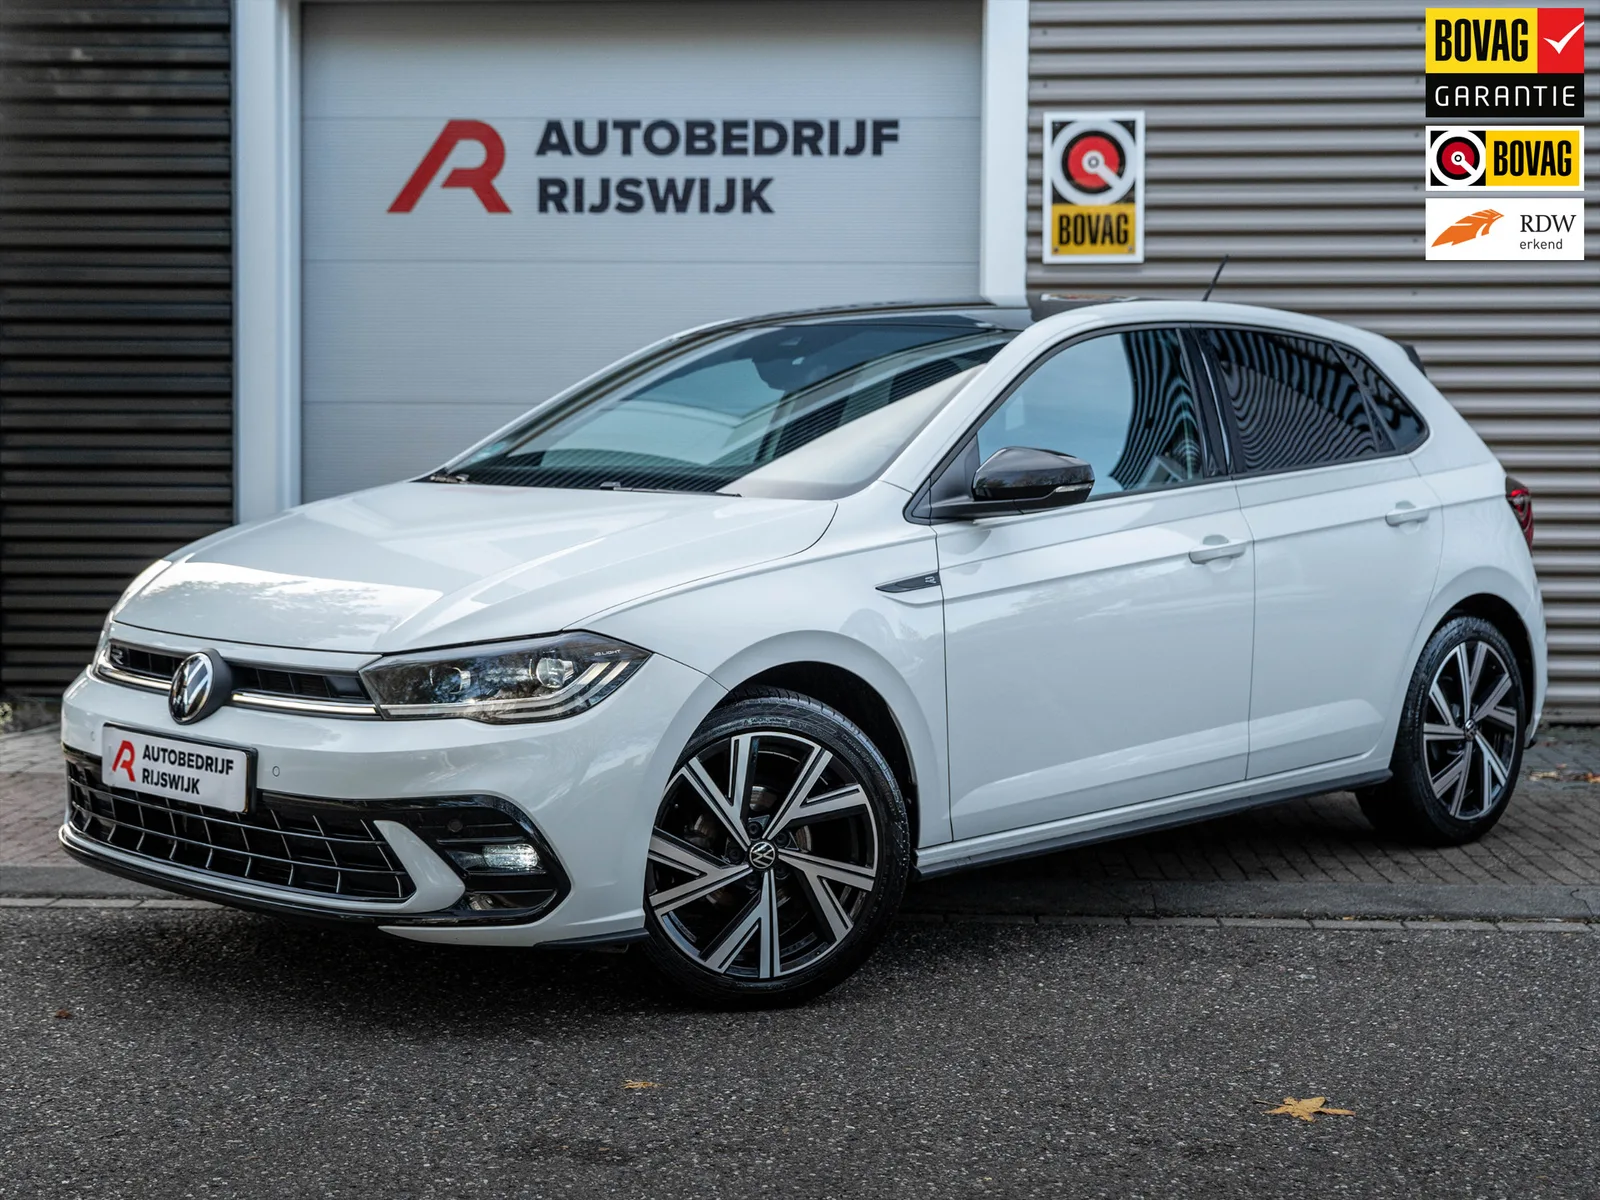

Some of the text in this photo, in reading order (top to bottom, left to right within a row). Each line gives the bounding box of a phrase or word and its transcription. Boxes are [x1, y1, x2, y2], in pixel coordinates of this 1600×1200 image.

[535, 119, 900, 157] AUTOBEDRIJF
[537, 177, 775, 214] RIJSWIJK
[1058, 213, 1129, 246] BOVAG
[142, 744, 235, 776] AUTOBEDRIJF
[142, 768, 201, 795] RIJSWIJK
